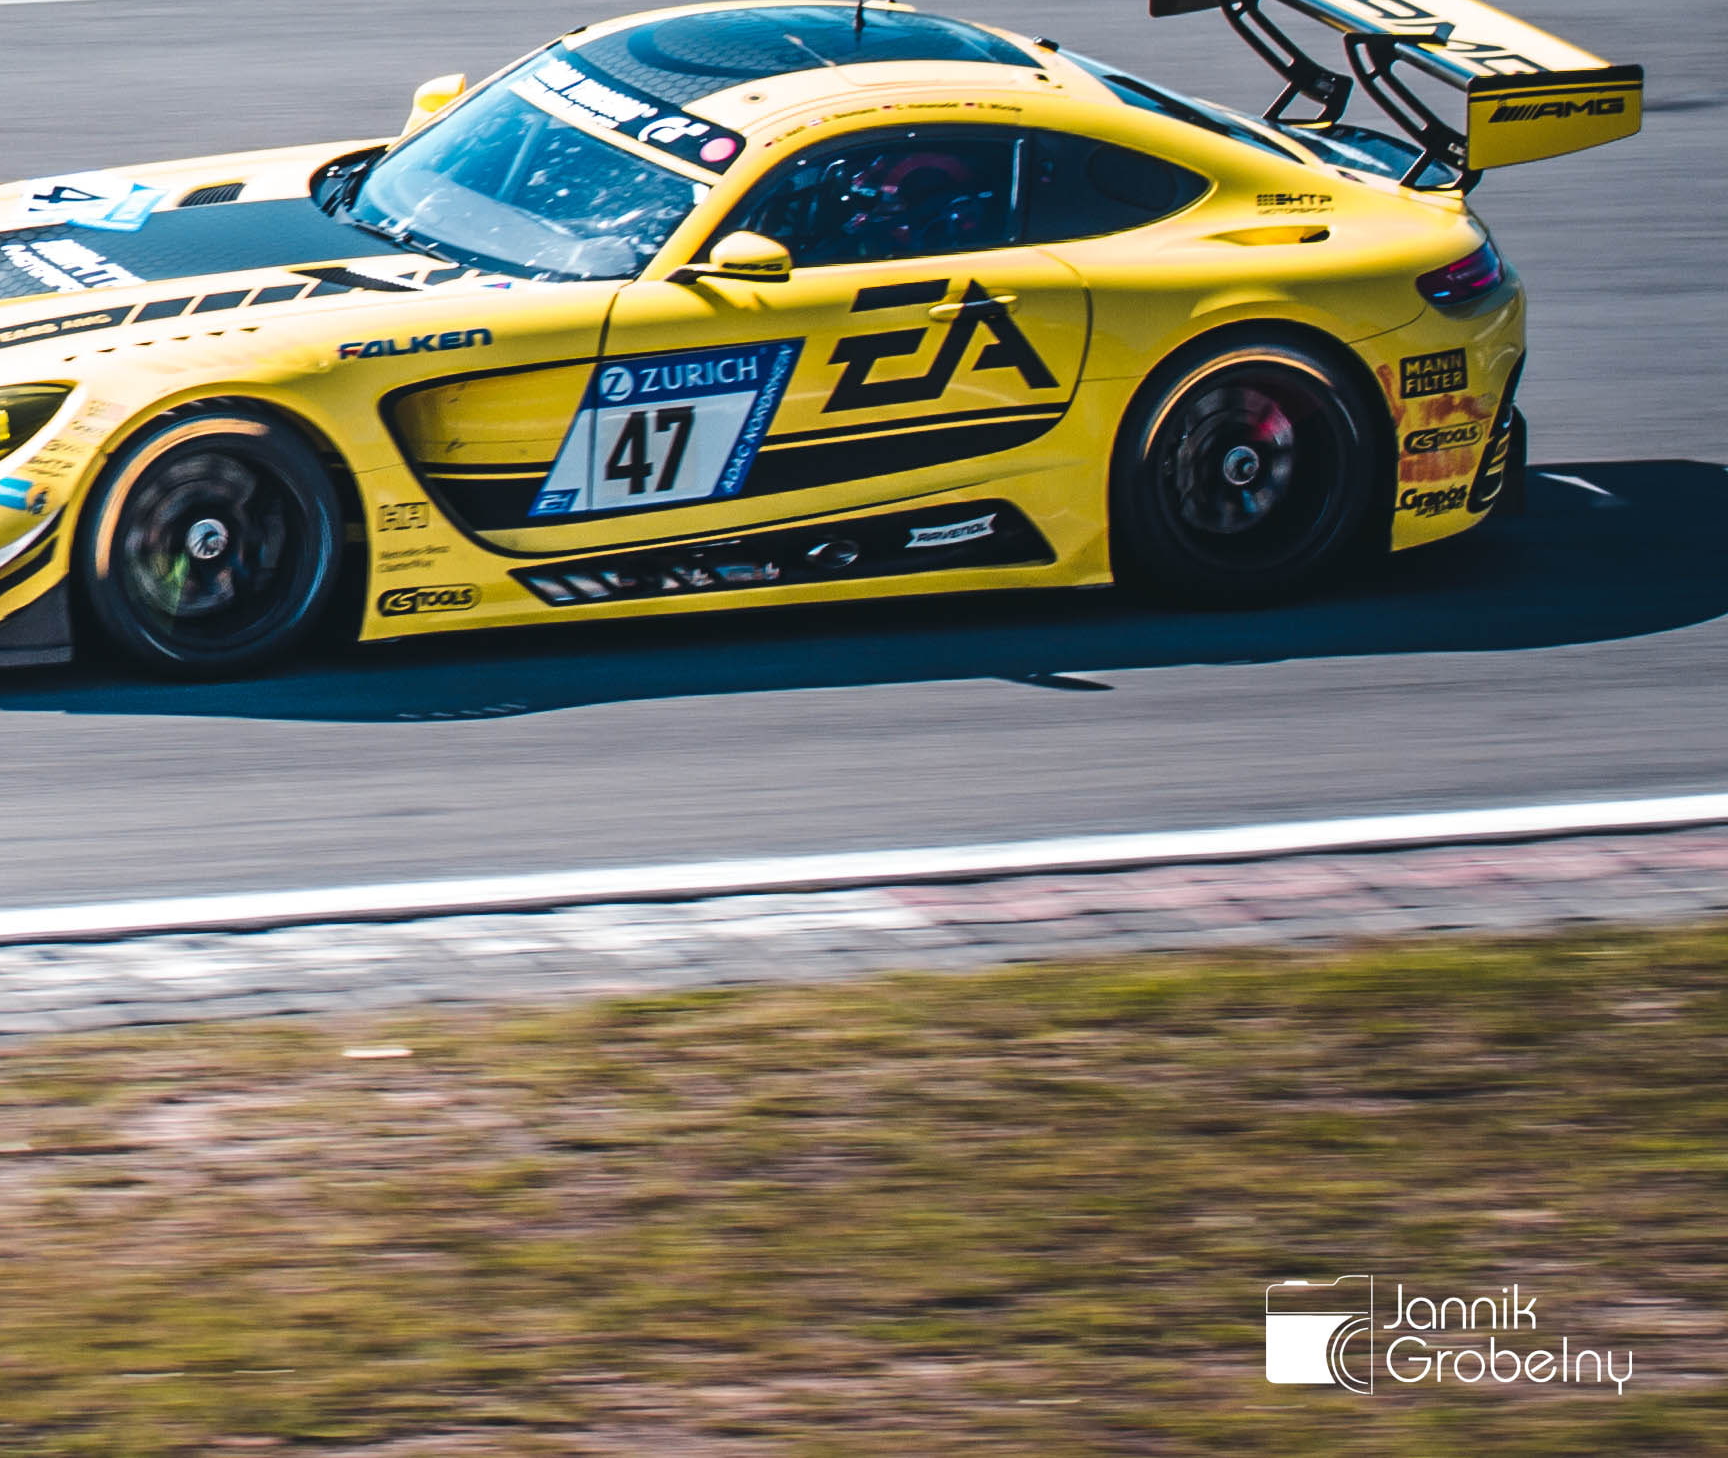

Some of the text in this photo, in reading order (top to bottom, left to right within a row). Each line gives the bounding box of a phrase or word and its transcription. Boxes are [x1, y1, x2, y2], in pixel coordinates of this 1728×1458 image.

[1530, 97, 1625, 121] AMG
[338, 327, 493, 360] FALKEN
[820, 277, 1061, 414] EA
[639, 356, 759, 394] ZURICH
[1405, 354, 1465, 376] MANN
[1405, 372, 1464, 393] FILTER
[604, 405, 696, 496] 47
[915, 520, 987, 545] RAVENOL
